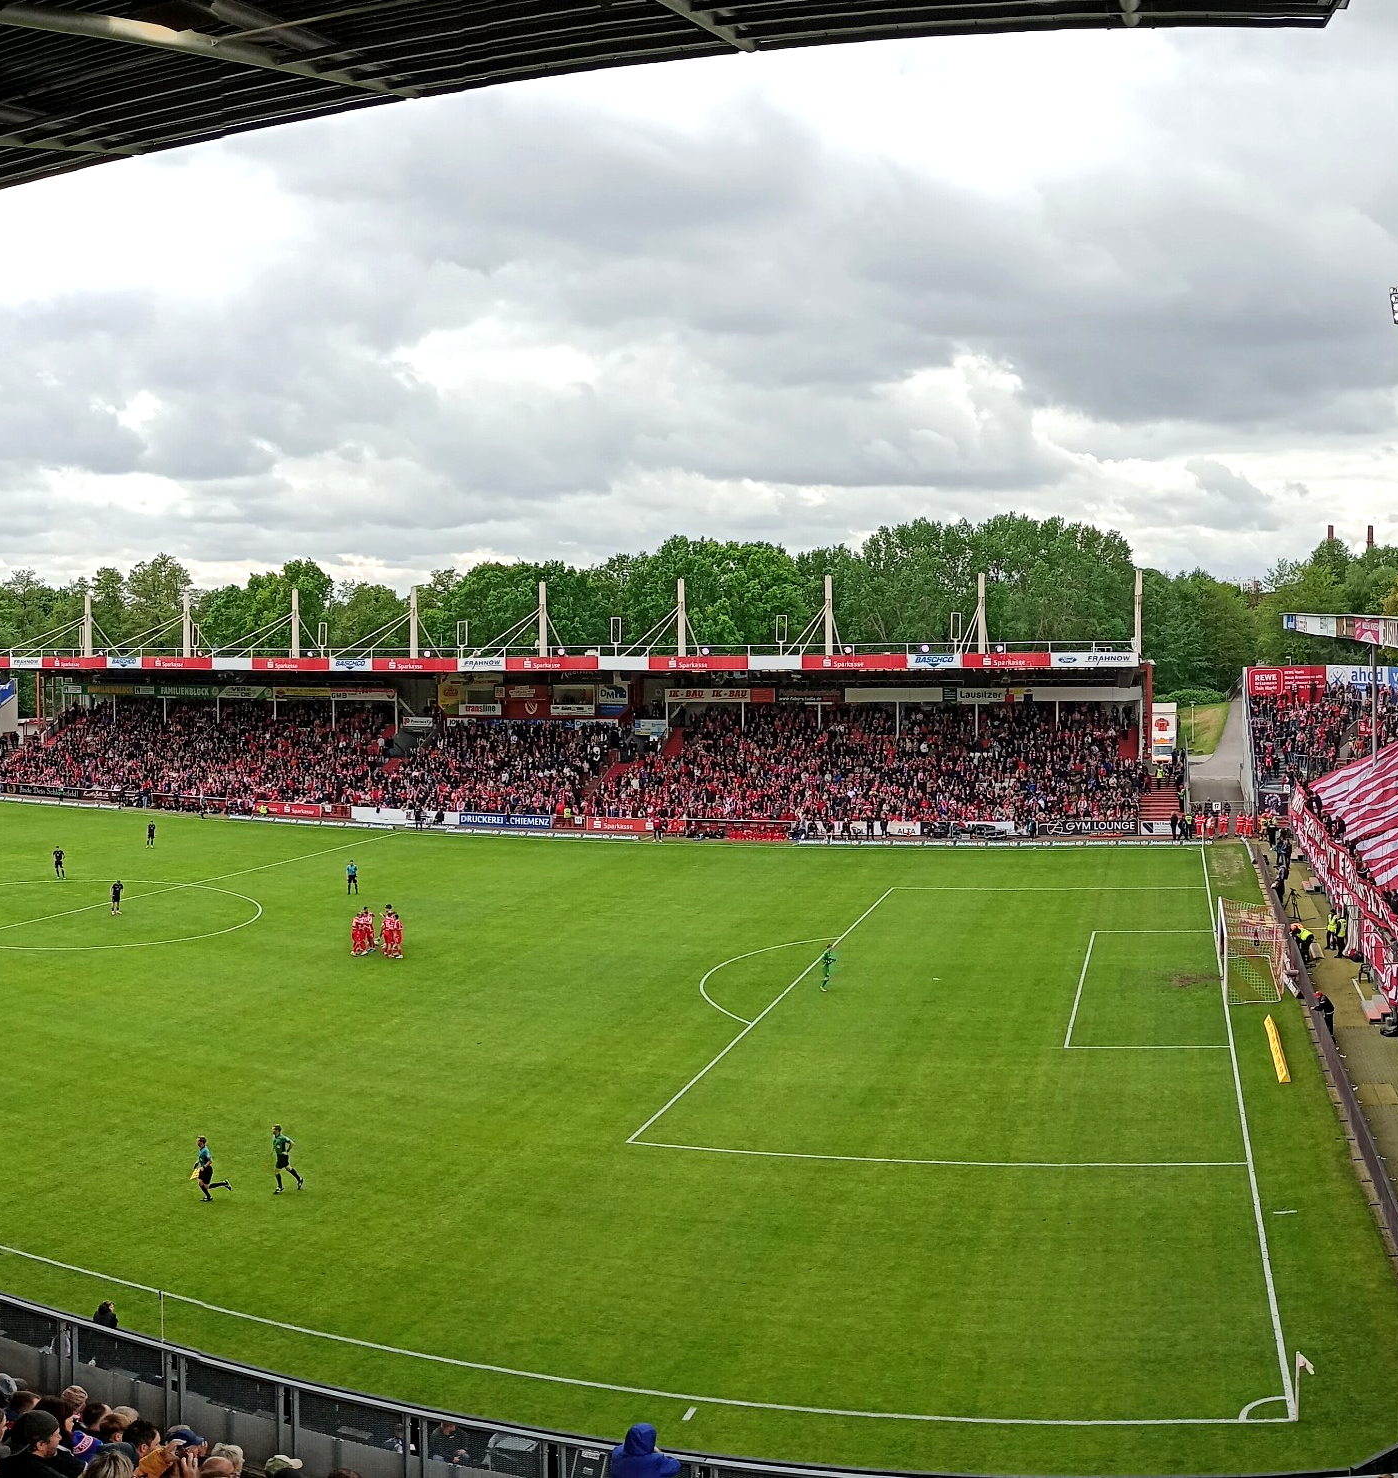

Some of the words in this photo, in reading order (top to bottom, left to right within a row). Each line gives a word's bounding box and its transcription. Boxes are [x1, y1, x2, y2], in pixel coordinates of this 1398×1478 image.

[465, 660, 501, 668] FRAHNOW
[833, 660, 864, 668] Sparkasse
[915, 656, 953, 664] BASCHCO
[993, 659, 1026, 667] Sparkasse
[1087, 656, 1131, 664] FRAHNOW
[397, 662, 423, 670] Sparkasse
[679, 661, 707, 669] Sparkasse
[1351, 668, 1383, 682] ahod
[87, 686, 133, 694] FAMILIENBLOCK
[161, 687, 209, 696] FAMILIENBLOCK
[600, 689, 615, 699] DM
[686, 690, 705, 698] BAU
[729, 690, 747, 698] BAU
[465, 705, 496, 713] transline
[461, 814, 503, 824] DRUCKEREI
[603, 822, 633, 831] Sparkasse
[1066, 821, 1091, 831] GYM
[1094, 821, 1136, 830] LOUNGE
